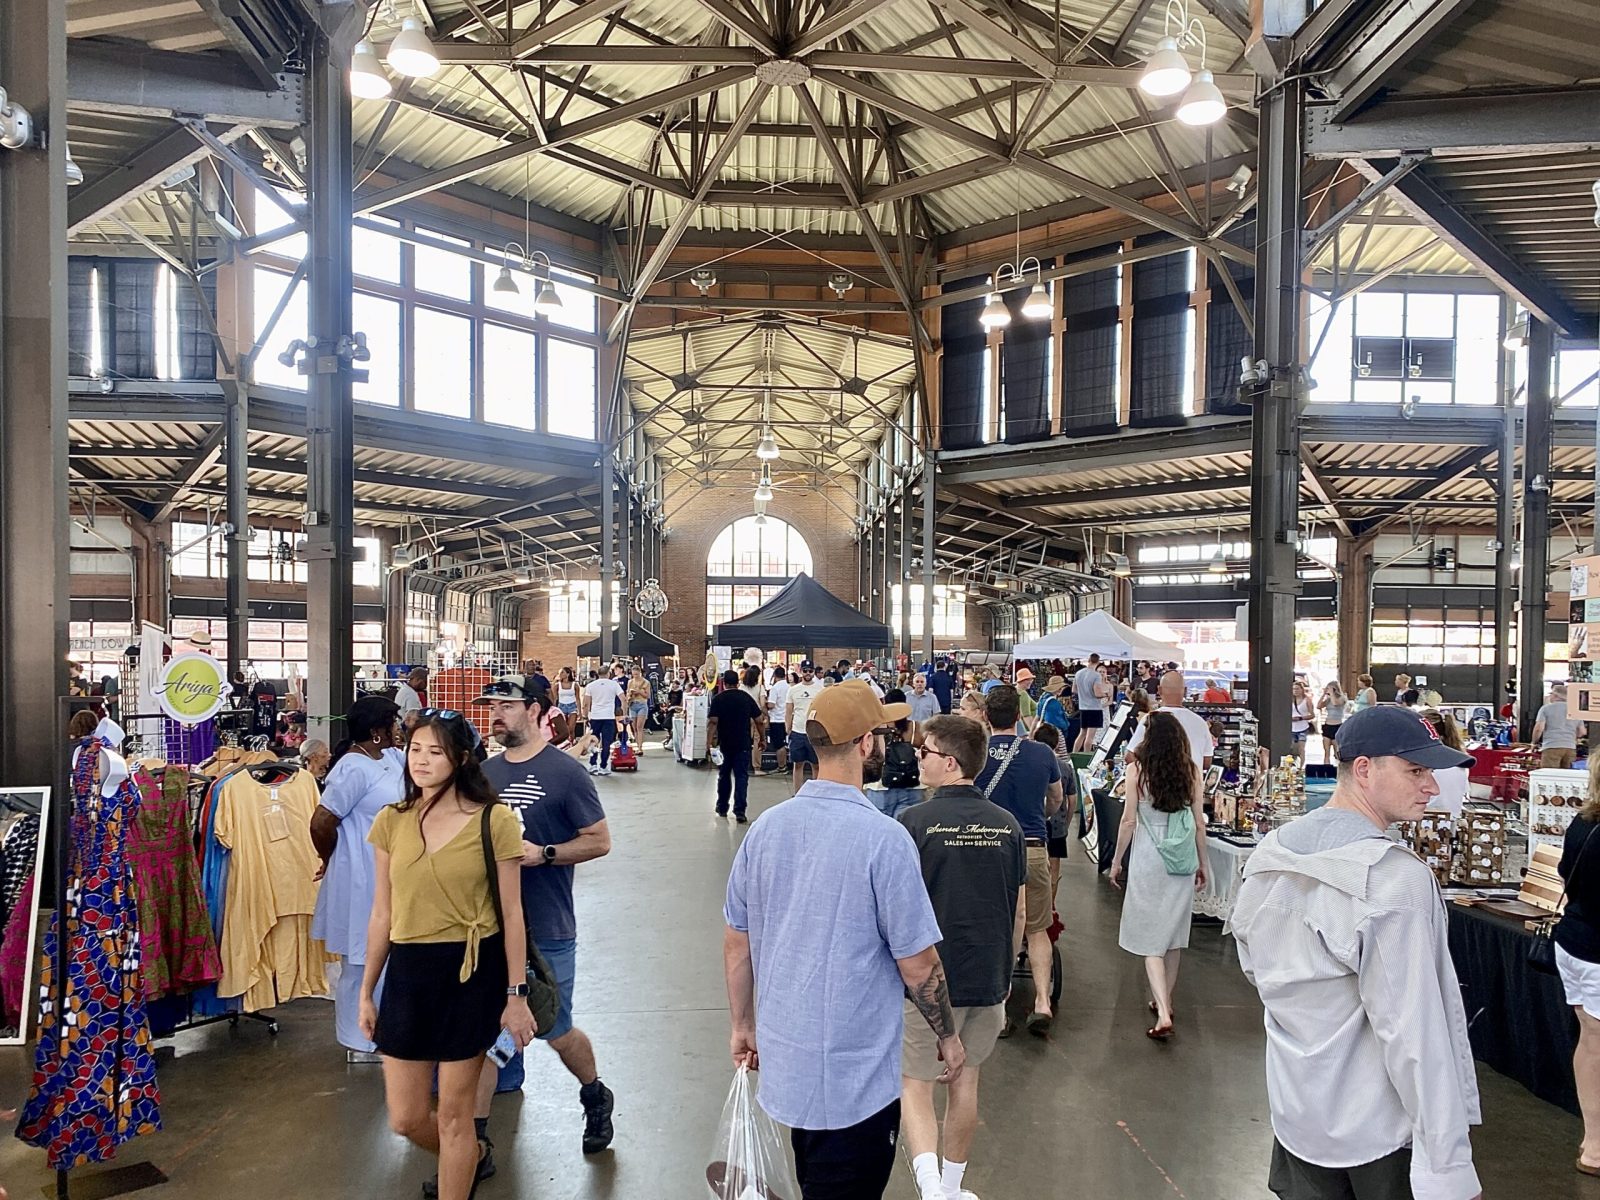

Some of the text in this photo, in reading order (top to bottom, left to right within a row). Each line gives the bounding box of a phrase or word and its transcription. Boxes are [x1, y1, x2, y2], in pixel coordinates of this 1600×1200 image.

[101, 638, 125, 649] COW
[155, 672, 228, 703] Ariya's
[926, 823, 1012, 839] Sunset Motorcycles
